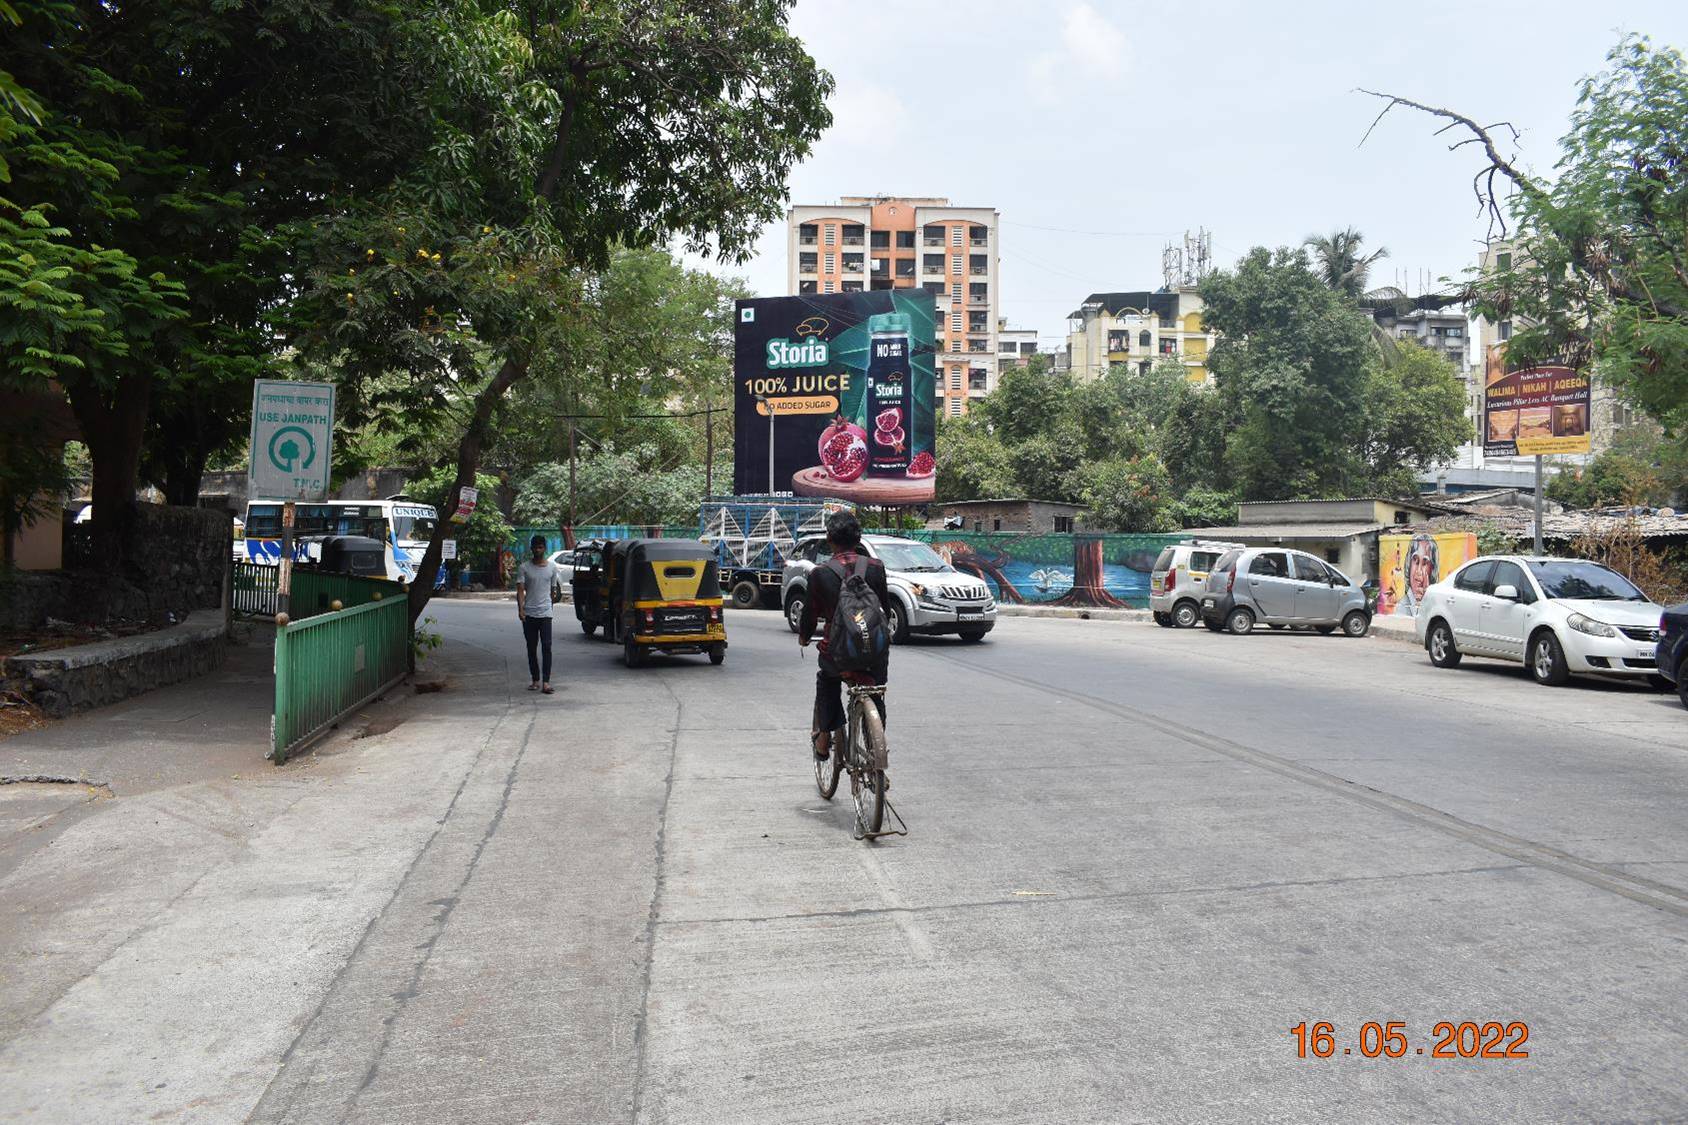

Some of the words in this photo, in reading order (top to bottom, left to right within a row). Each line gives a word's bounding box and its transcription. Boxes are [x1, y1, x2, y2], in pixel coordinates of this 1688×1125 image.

[768, 339, 827, 366] Storia
[876, 344, 889, 357] NO
[745, 377, 787, 395] 100%
[792, 374, 850, 393] JUICE
[876, 383, 903, 396] Storia
[1487, 387, 1515, 397] WALIMA
[1522, 381, 1547, 393] NIKAH
[1554, 378, 1587, 390] AQEEQA
[777, 402, 804, 410] ADDED
[805, 400, 831, 408] SUGAR
[259, 412, 280, 423] USE
[282, 413, 327, 425] JANPATH
